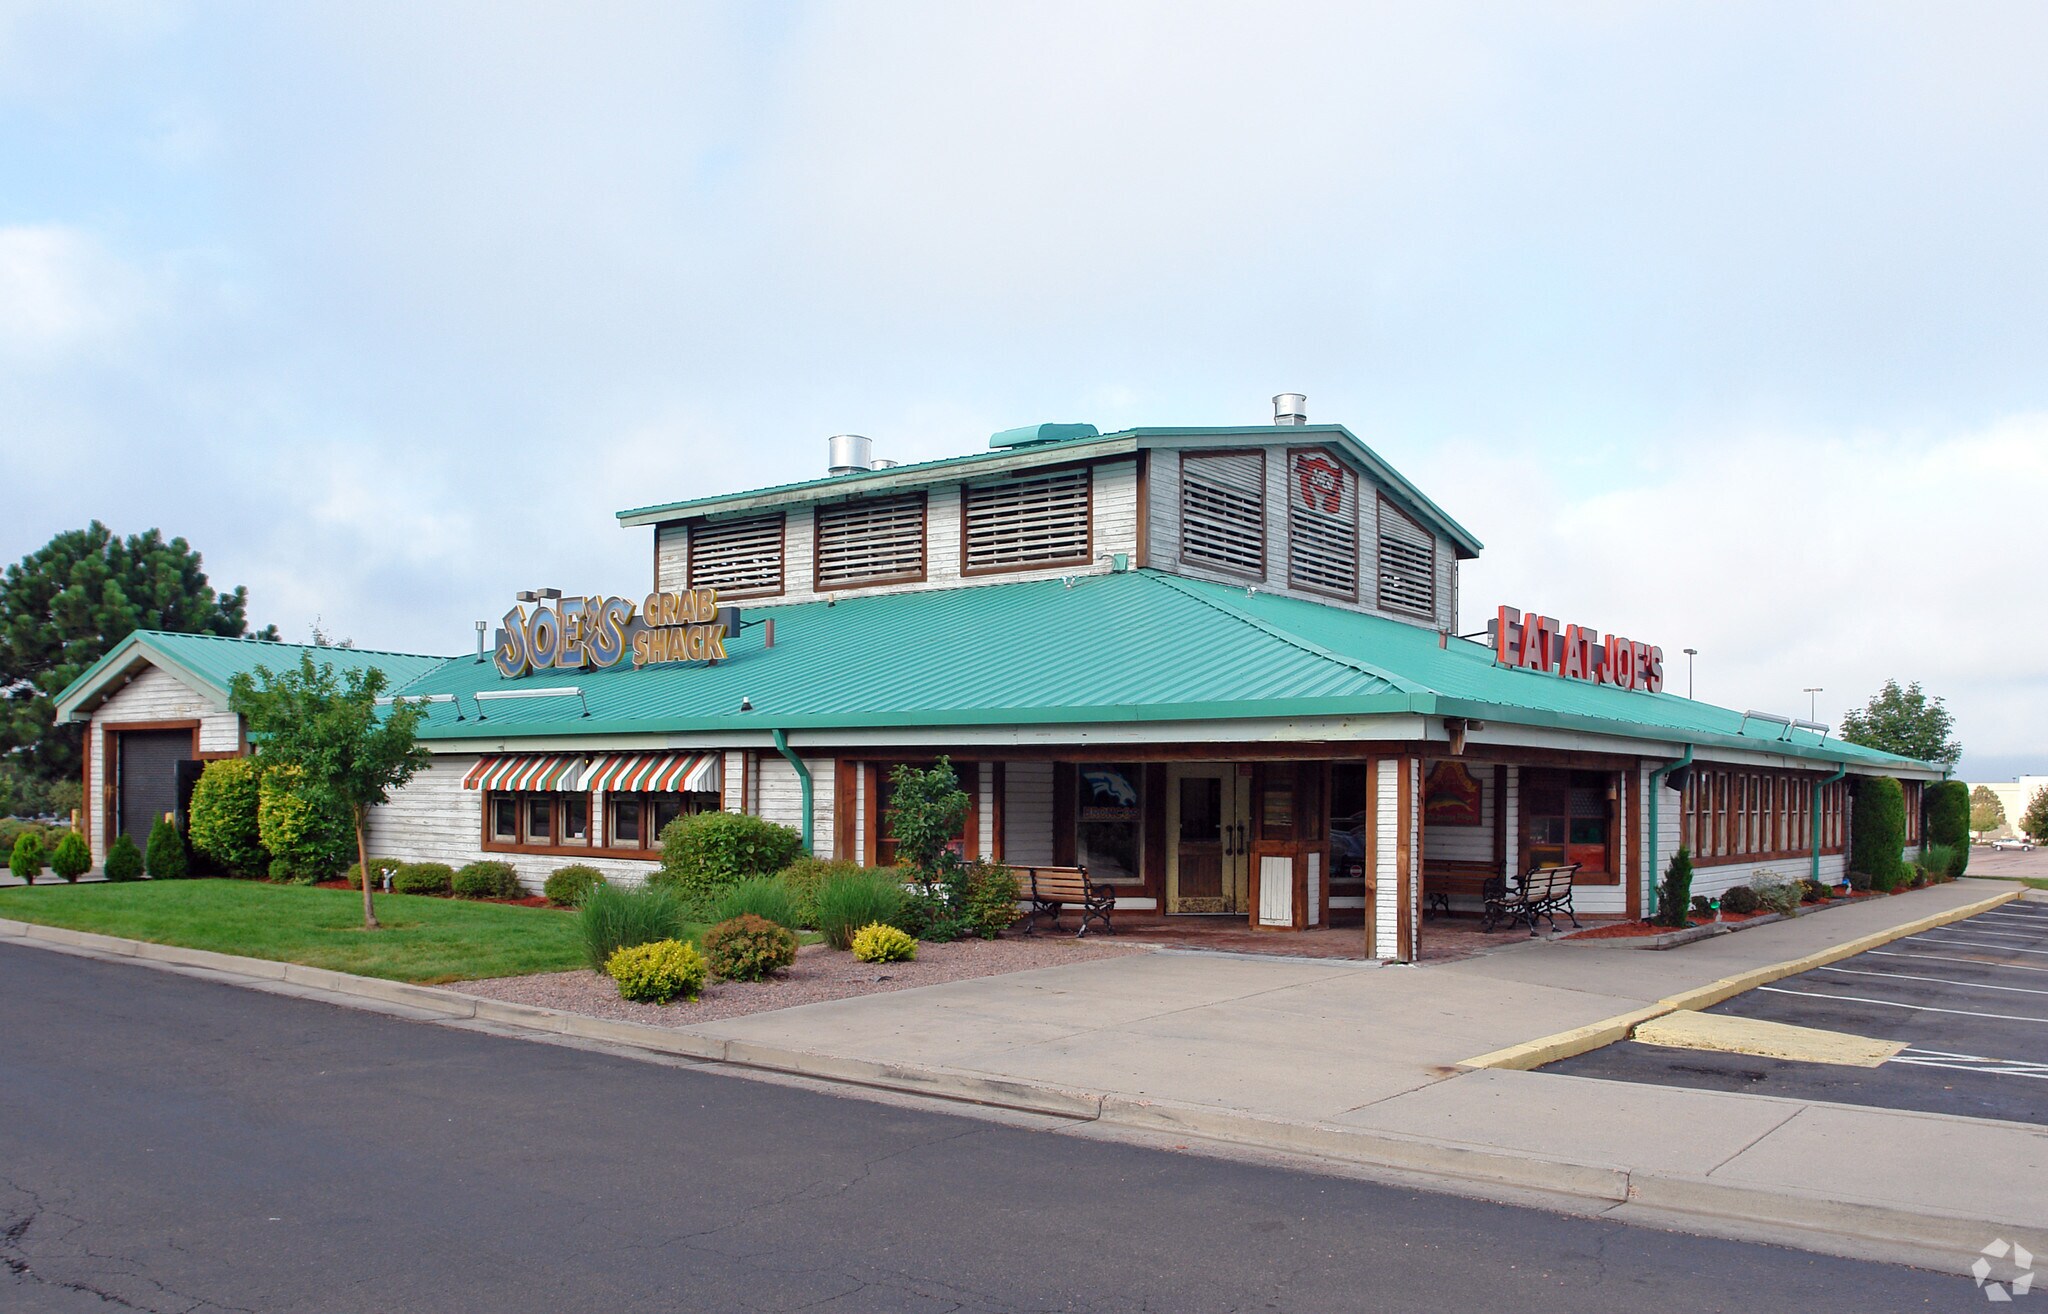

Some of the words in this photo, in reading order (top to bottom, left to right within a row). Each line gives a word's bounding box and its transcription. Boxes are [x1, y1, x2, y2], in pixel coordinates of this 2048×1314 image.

[493, 595, 636, 678] JOE'S
[642, 588, 718, 627] CRAB
[632, 623, 727, 665] SHACK
[1498, 605, 1559, 672] EAT
[1559, 624, 1597, 679] AT
[1600, 634, 1664, 693] JOE'S
